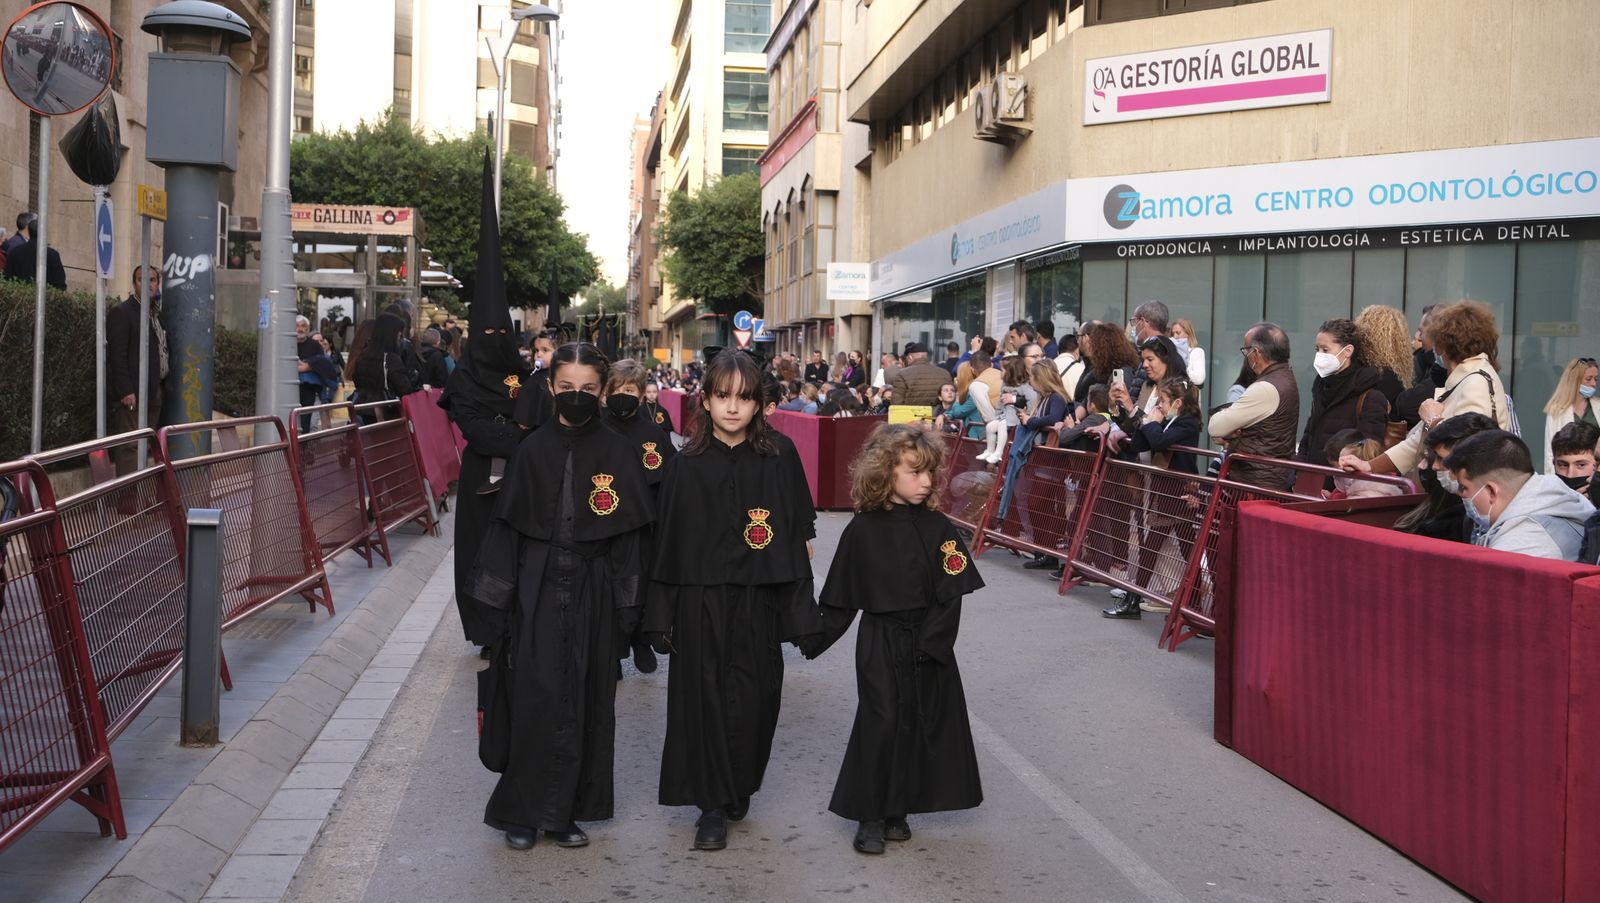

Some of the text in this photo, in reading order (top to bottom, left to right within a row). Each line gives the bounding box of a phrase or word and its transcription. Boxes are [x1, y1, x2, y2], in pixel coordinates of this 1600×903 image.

[1120, 42, 1320, 89] GESTORÍA GLOBAL
[1116, 169, 1598, 222] Zamora CENTRO ODONTOLÓGICO
[313, 207, 373, 225] GALLINA
[1116, 224, 1571, 257] ORTODONCIA IMPLANTOLOGÍA ESTETICA DENTAL
[834, 270, 866, 280] Zamora
